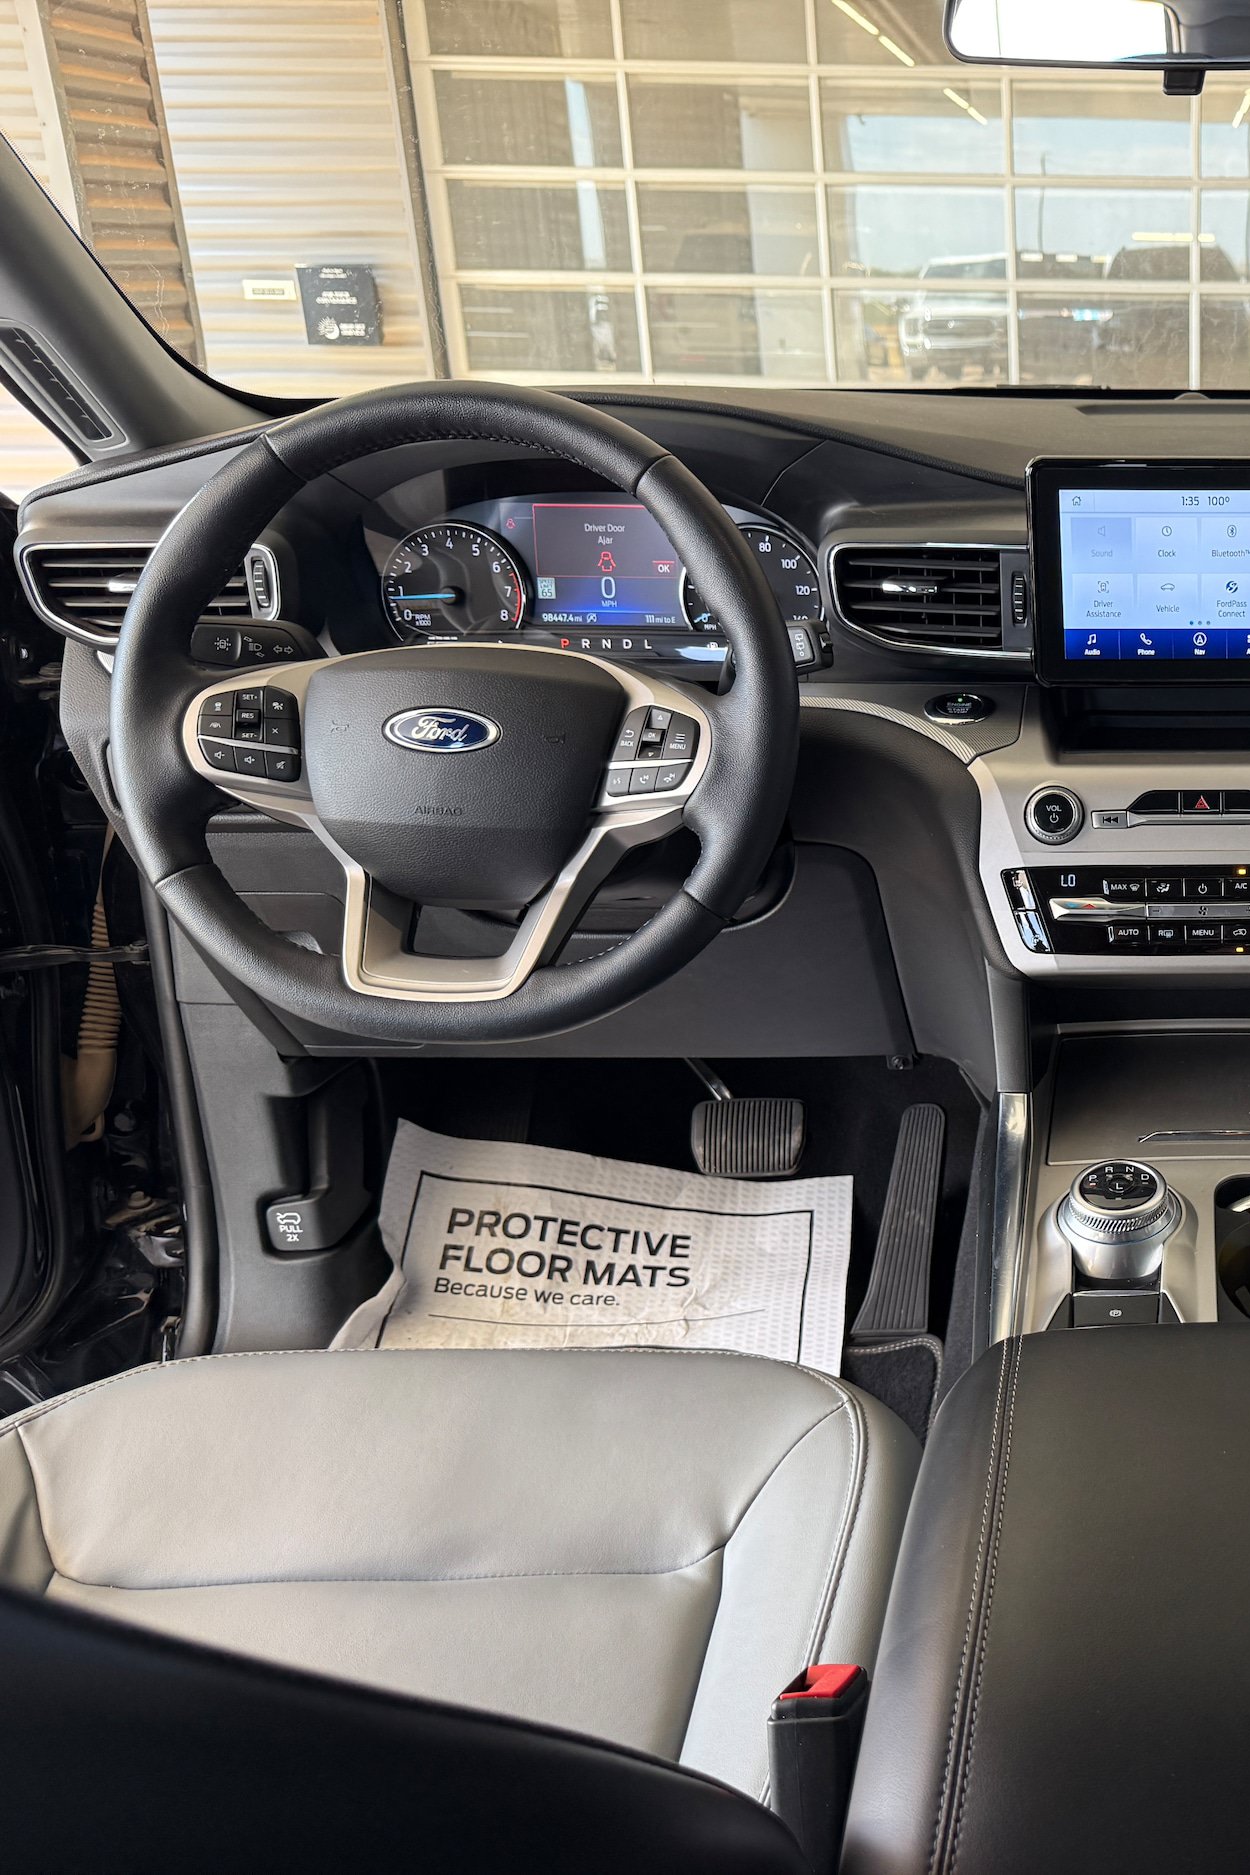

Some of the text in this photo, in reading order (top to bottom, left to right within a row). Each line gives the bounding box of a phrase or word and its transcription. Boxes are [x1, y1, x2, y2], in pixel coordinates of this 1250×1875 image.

[1181, 496, 1200, 506] 1:35
[584, 523, 625, 532] Driver Door
[445, 537, 454, 549] 4
[597, 536, 613, 545] Ajar
[420, 544, 429, 556] 3
[471, 544, 480, 556] 5
[758, 542, 772, 552] 80
[1091, 549, 1113, 557] Sound
[1157, 549, 1176, 557] Clock
[404, 561, 412, 573] 2
[492, 561, 501, 573] 6
[657, 564, 670, 573] OK
[781, 559, 797, 569] 100
[504, 586, 512, 597] 7
[601, 576, 616, 599] 0
[795, 586, 810, 595] 120
[541, 588, 553, 598] 65
[1093, 600, 1113, 608] Driver
[403, 609, 412, 621] 0
[500, 610, 509, 621] 8
[1086, 610, 1122, 618] Assistance
[1218, 610, 1246, 618] Connect
[560, 639, 652, 648] P R N D L
[411, 715, 470, 742] Ford
[1060, 874, 1076, 887] LO
[279, 1225, 304, 1233] PULL
[447, 1207, 692, 1258] PROTECTIVE
[286, 1234, 300, 1242] 2X
[438, 1243, 691, 1287] FLOOR MATS
[434, 1276, 620, 1306] Because we care.
